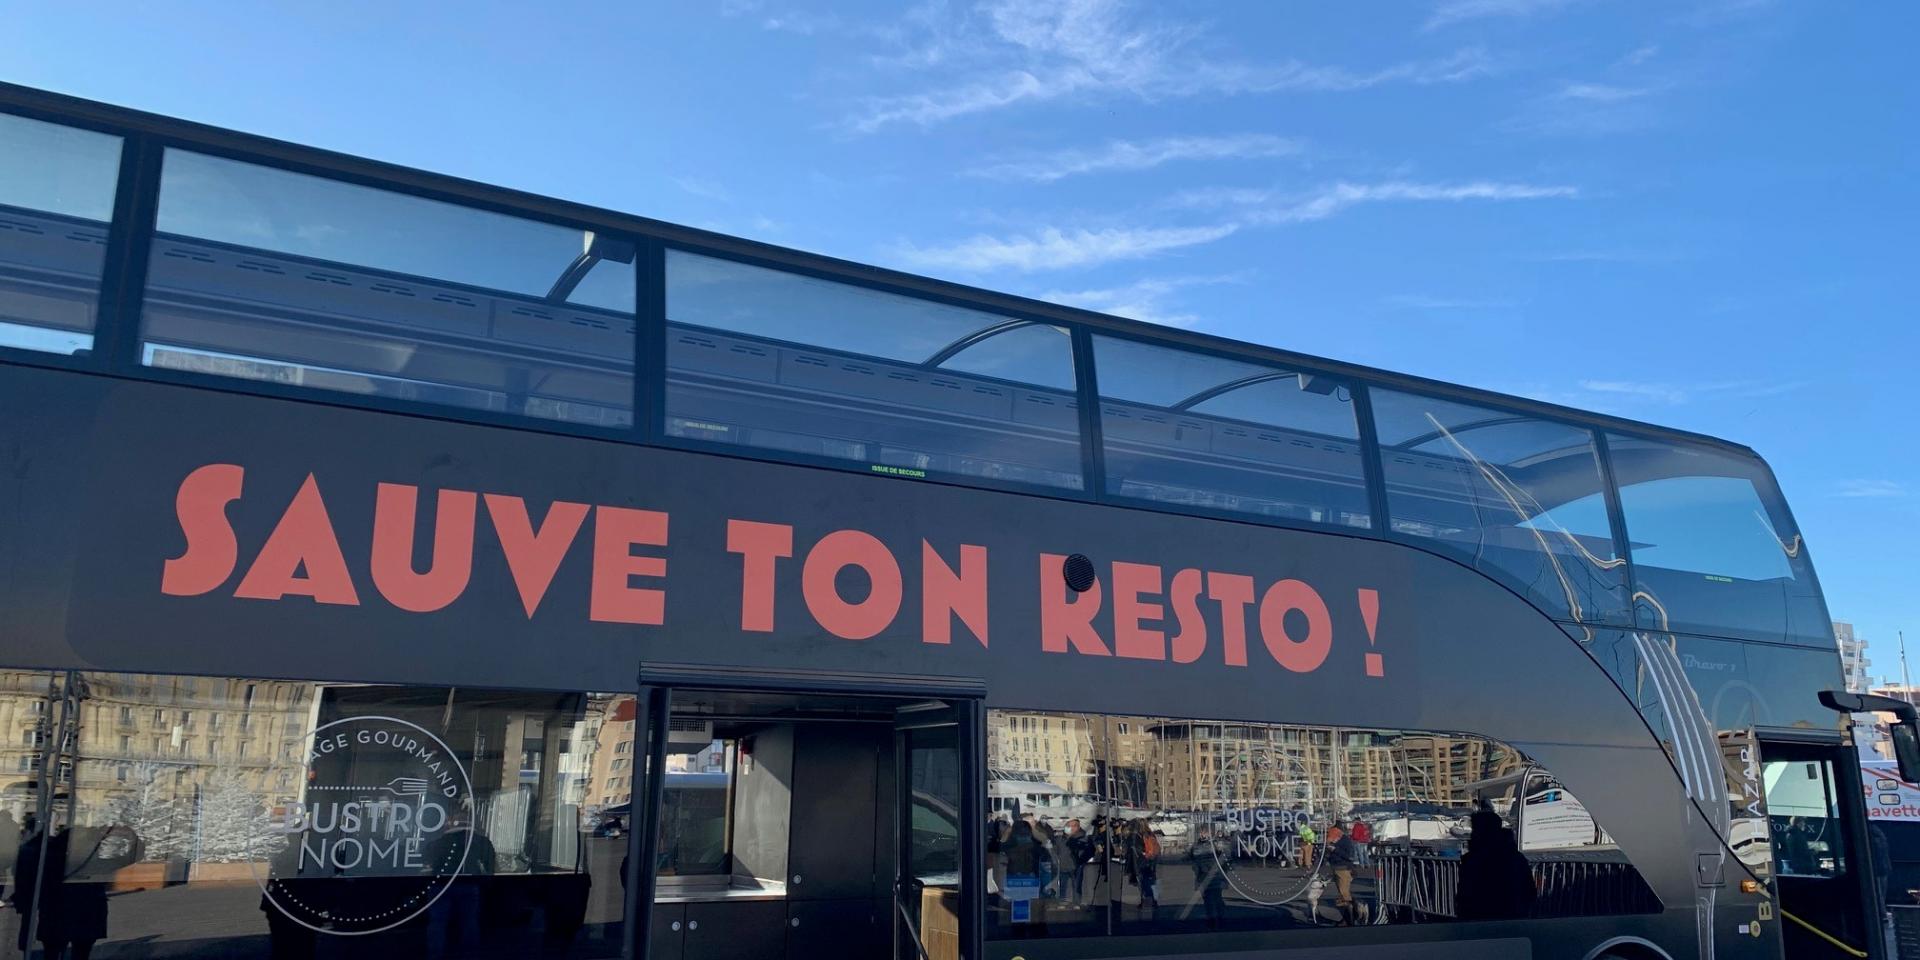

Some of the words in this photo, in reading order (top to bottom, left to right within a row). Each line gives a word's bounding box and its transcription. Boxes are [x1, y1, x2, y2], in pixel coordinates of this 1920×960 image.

[161, 464, 668, 625] SAUVE
[727, 519, 988, 648] TON
[1040, 553, 1332, 673] RESTO
[1358, 588, 1383, 676] !
[356, 729, 458, 799] GOURMAND
[284, 801, 446, 834] BUSTRO
[1226, 808, 1311, 833] BUSTRO
[297, 837, 425, 870] NOME
[1236, 834, 1304, 859] NOME
